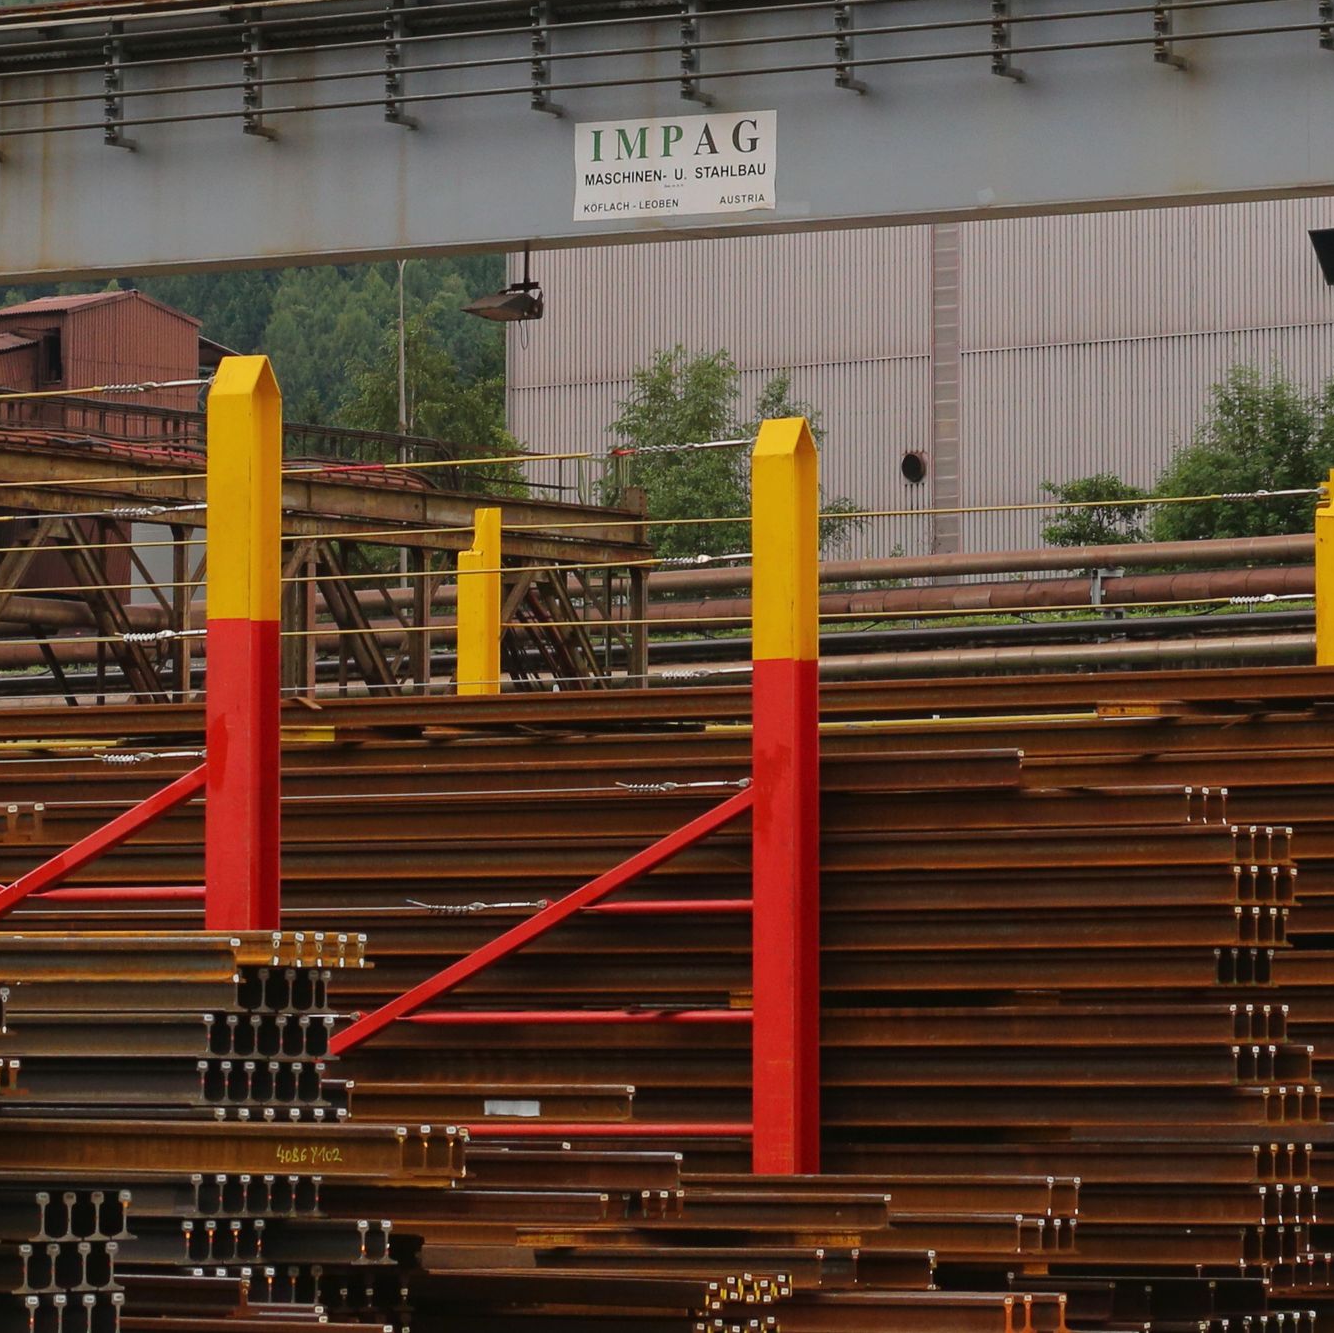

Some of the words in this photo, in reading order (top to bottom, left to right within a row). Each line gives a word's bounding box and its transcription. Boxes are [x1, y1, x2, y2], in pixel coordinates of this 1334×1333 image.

[590, 119, 760, 162] IMPAG
[585, 169, 667, 186] MASCHINEN-
[674, 168, 687, 181] U.
[694, 163, 767, 179] STAHLBAU
[639, 199, 679, 210] LEOBEN
[719, 193, 765, 205] AUSTRIA
